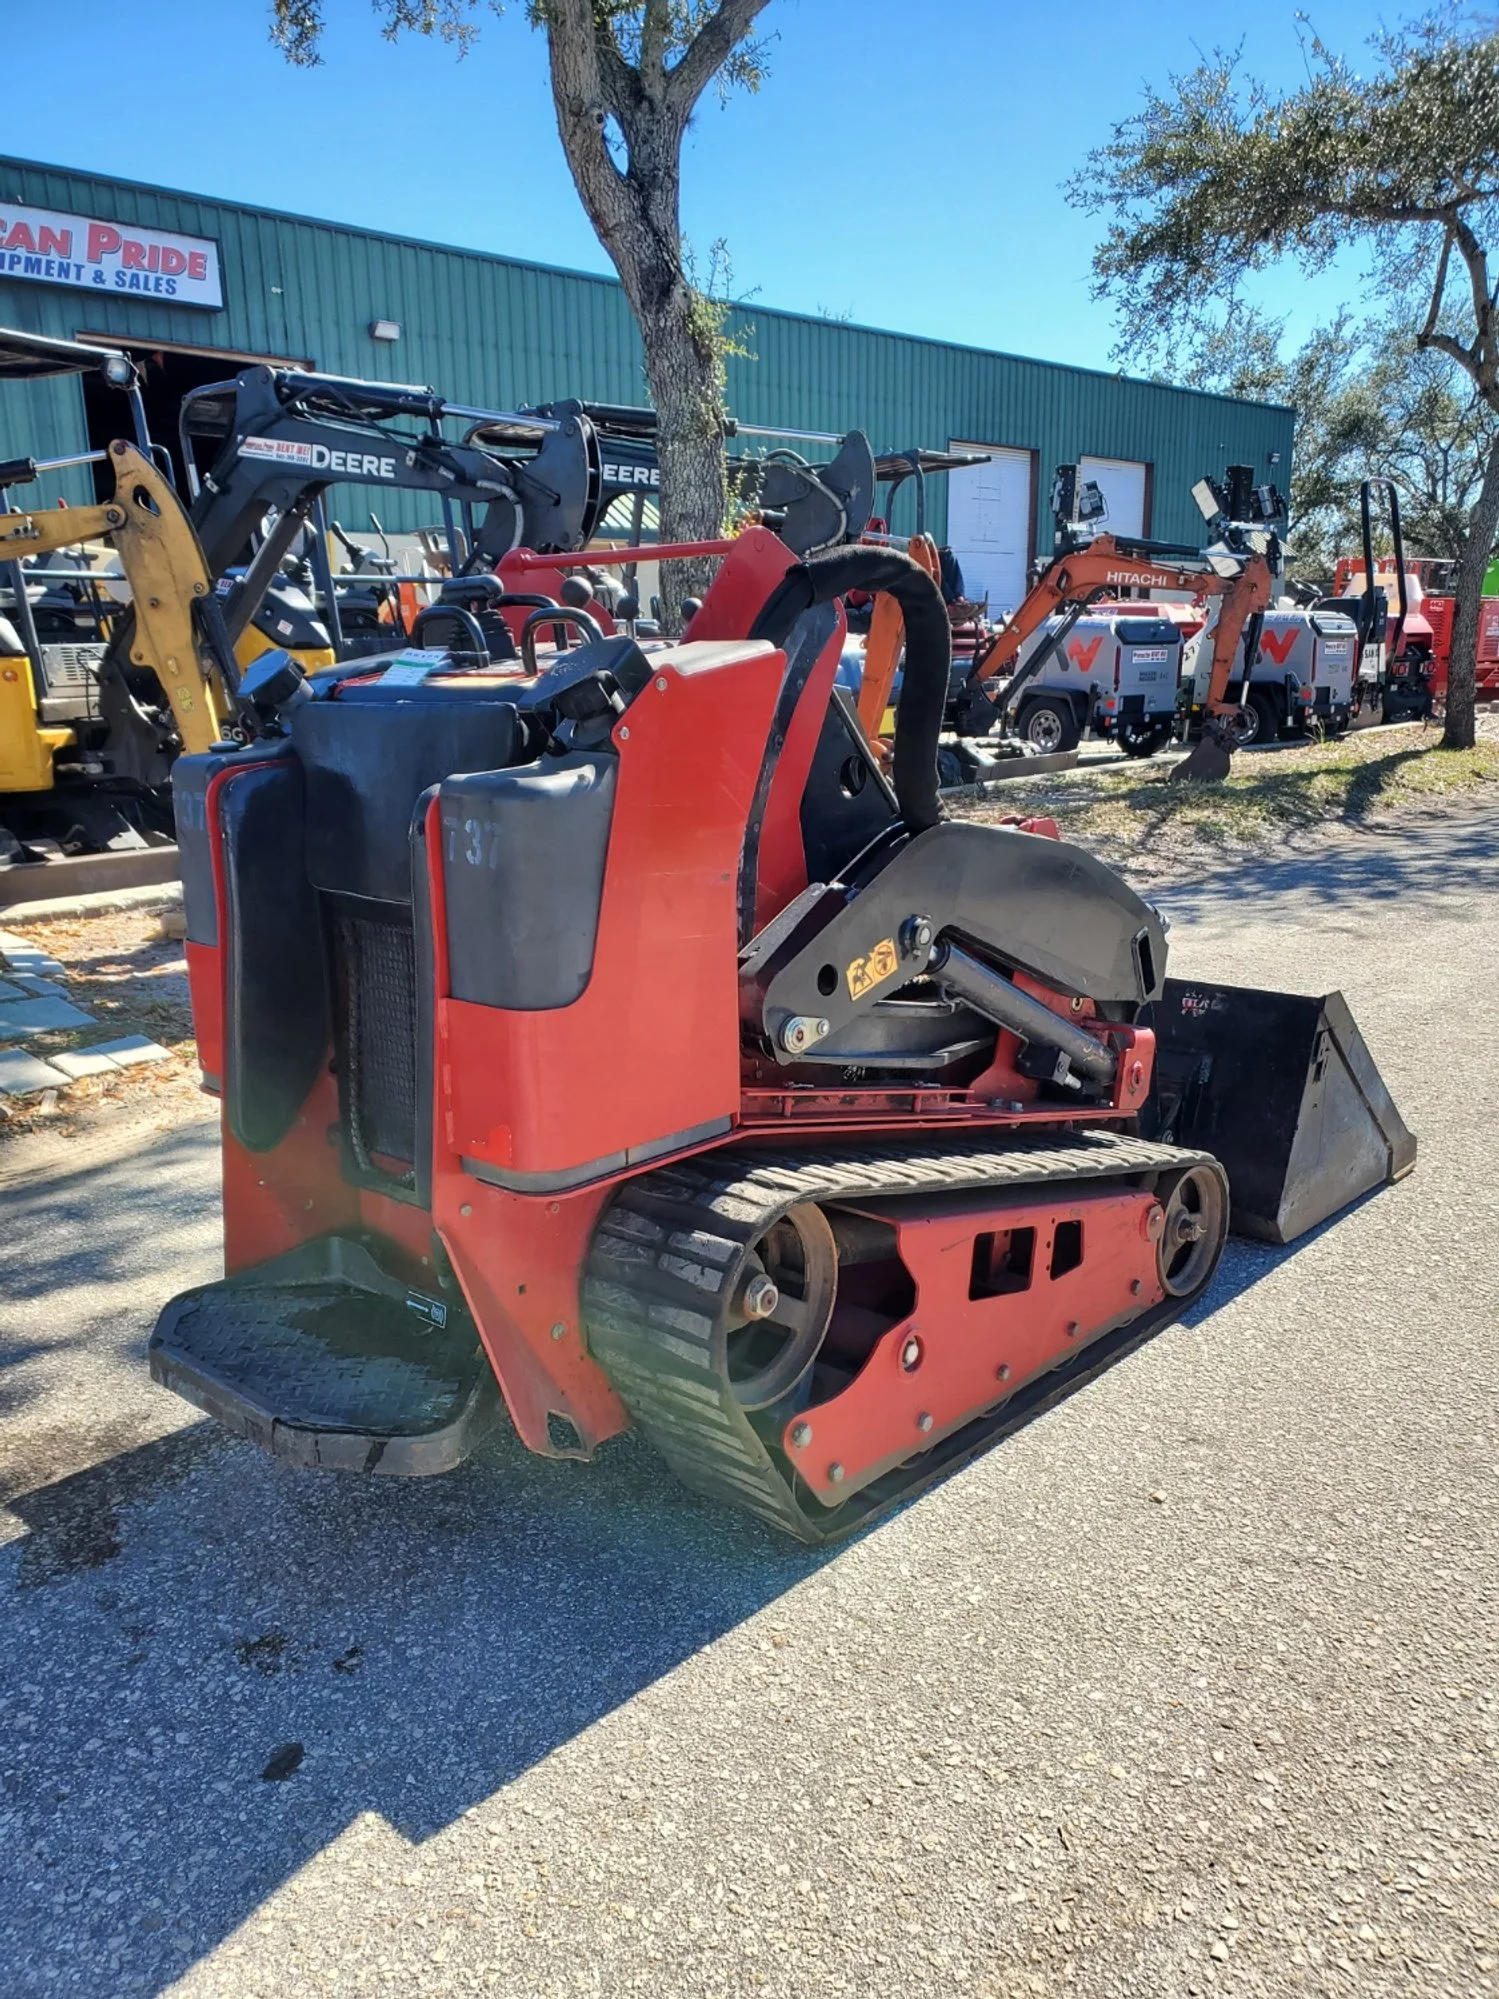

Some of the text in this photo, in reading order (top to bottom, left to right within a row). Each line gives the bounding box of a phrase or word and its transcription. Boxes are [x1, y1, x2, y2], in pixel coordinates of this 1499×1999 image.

[92, 269, 106, 285] &
[115, 270, 177, 295] SALES
[312, 444, 395, 478] DEERE
[1106, 571, 1167, 586] HITACHI
